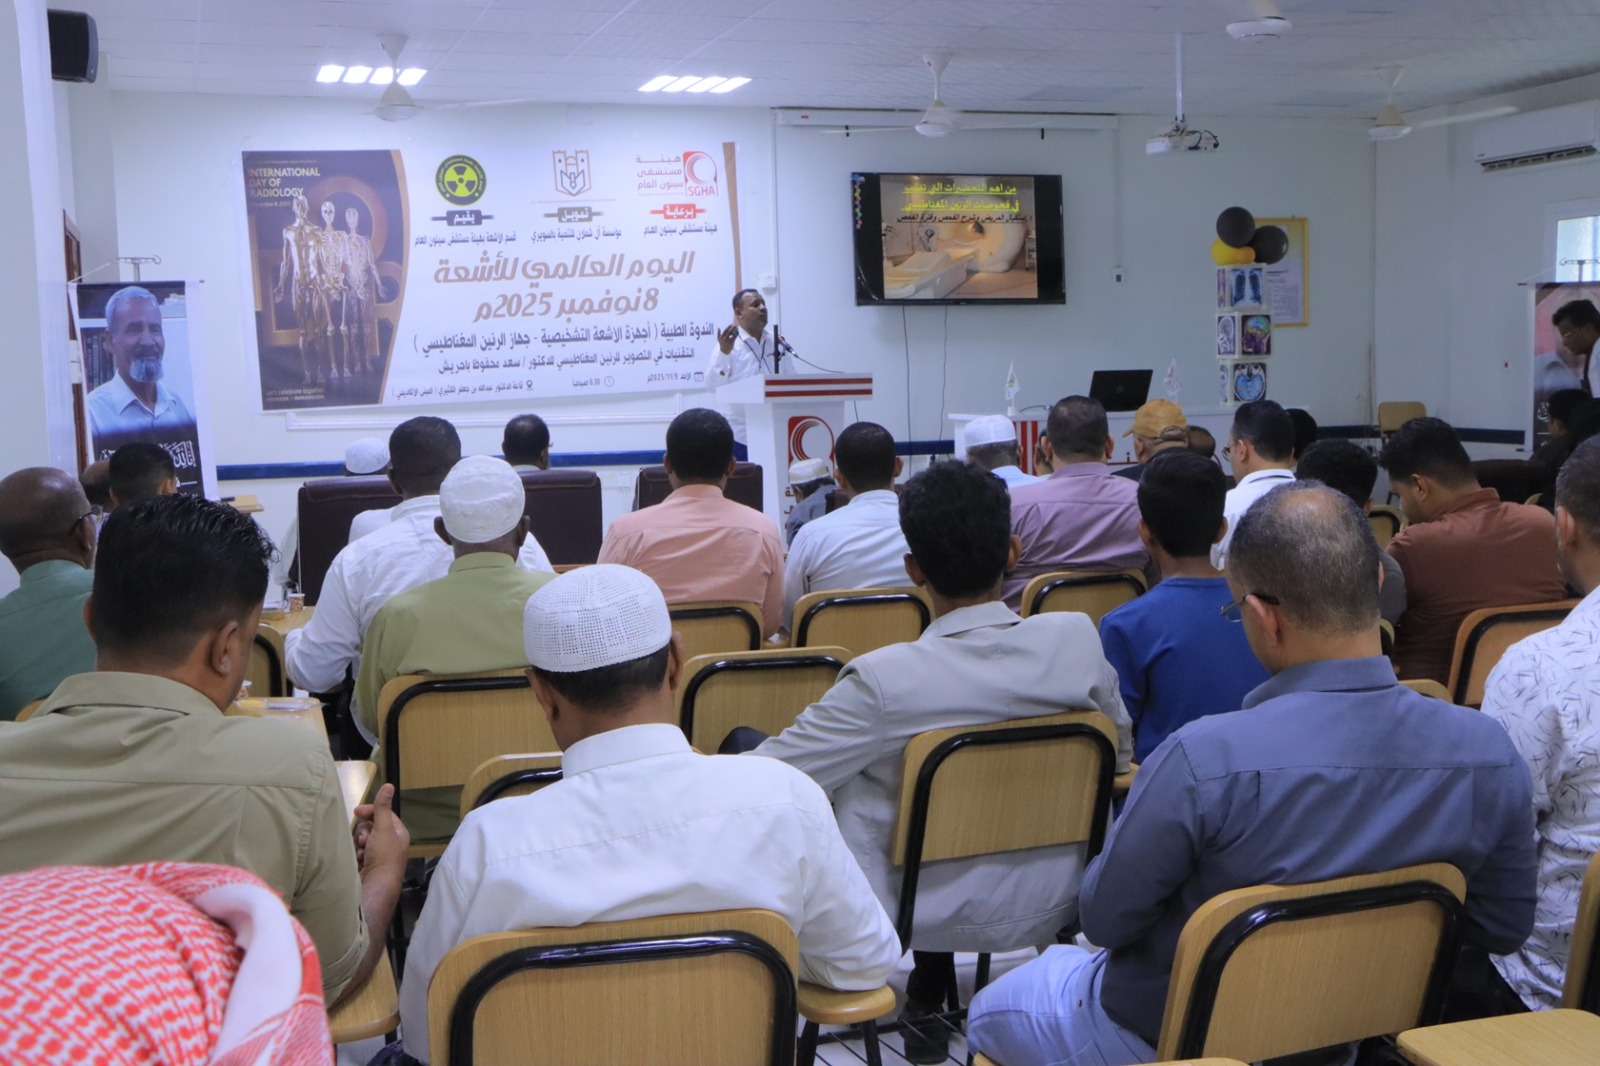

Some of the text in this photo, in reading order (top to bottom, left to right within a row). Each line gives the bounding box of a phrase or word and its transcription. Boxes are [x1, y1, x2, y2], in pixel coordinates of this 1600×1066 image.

[247, 167, 320, 177] INTERNATIONAL
[637, 168, 682, 178] مستشفى
[248, 178, 282, 188] DAY OF
[638, 180, 658, 190] العام
[1005, 186, 1016, 194] من
[249, 187, 304, 198] RADIOLOGY
[688, 186, 716, 196] SGHA
[666, 206, 694, 218] برعاية
[1011, 200, 1019, 212] في
[454, 210, 476, 225] يقيم
[561, 207, 589, 222] تمويل
[433, 250, 695, 288] اليوم العالمي للأشعة
[542, 326, 590, 348] التشخيصية
[625, 321, 651, 344] أجهزة
[661, 323, 687, 342] الطبية
[690, 322, 714, 340] الندوة
[422, 332, 477, 358] المغناطيسي
[480, 332, 506, 352] الرنين
[510, 332, 530, 350] جهاز
[528, 354, 554, 370] للدكتور
[556, 352, 598, 371] المغناطيسي
[622, 350, 652, 365] التصوير
[654, 348, 664, 366] في
[665, 348, 695, 362] التقنيات
[438, 358, 470, 374] باحريش
[472, 356, 500, 373] محفوظ
[502, 358, 520, 369] سعد
